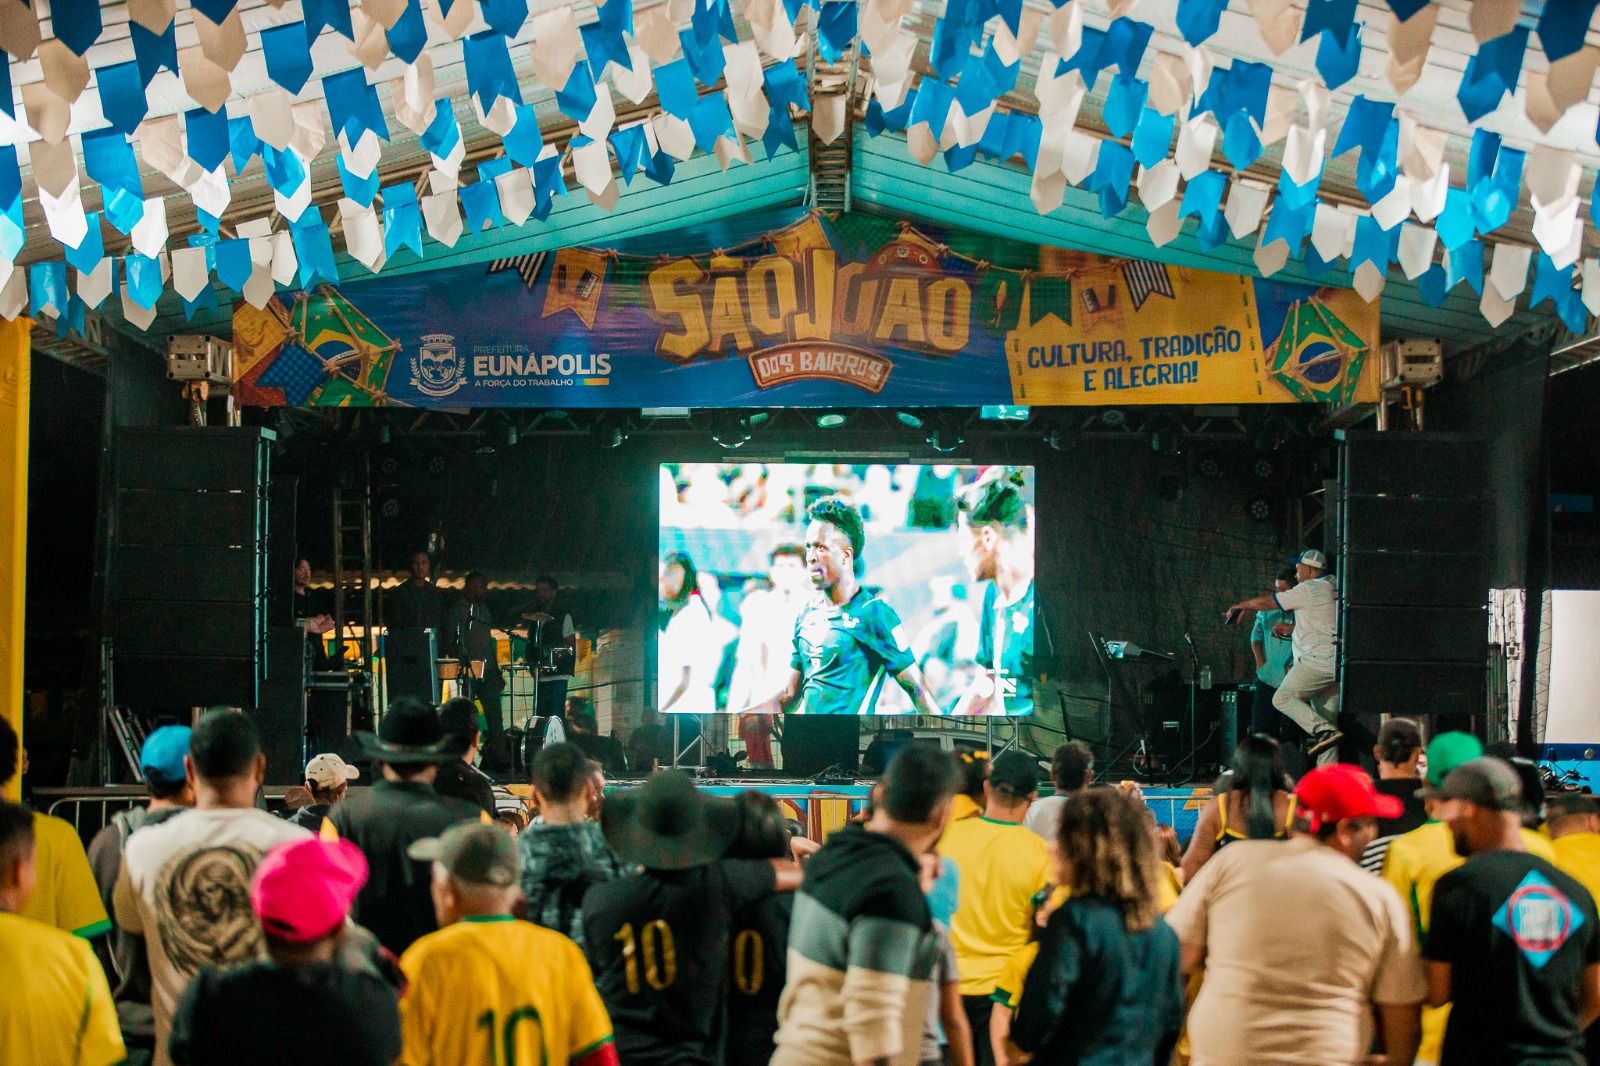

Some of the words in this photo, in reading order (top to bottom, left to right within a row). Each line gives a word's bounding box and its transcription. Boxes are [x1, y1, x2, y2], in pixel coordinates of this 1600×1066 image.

[648, 255, 797, 358] SÃO
[473, 345, 529, 353] PREFEITURA
[1027, 339, 1133, 369] CULTURA,
[1140, 325, 1242, 360] TRADIÇÃO
[473, 352, 612, 376] EUNÁPOLIS
[757, 353, 795, 378] DOS
[799, 351, 883, 381] BAIRROS
[1084, 369, 1098, 392] E
[1103, 360, 1199, 391] ALEGRIA!
[483, 379, 511, 389] FORÇA
[513, 379, 527, 387] DO
[528, 378, 574, 387] TRABALHO
[613, 918, 678, 995] 10
[477, 1006, 549, 1066] 10
